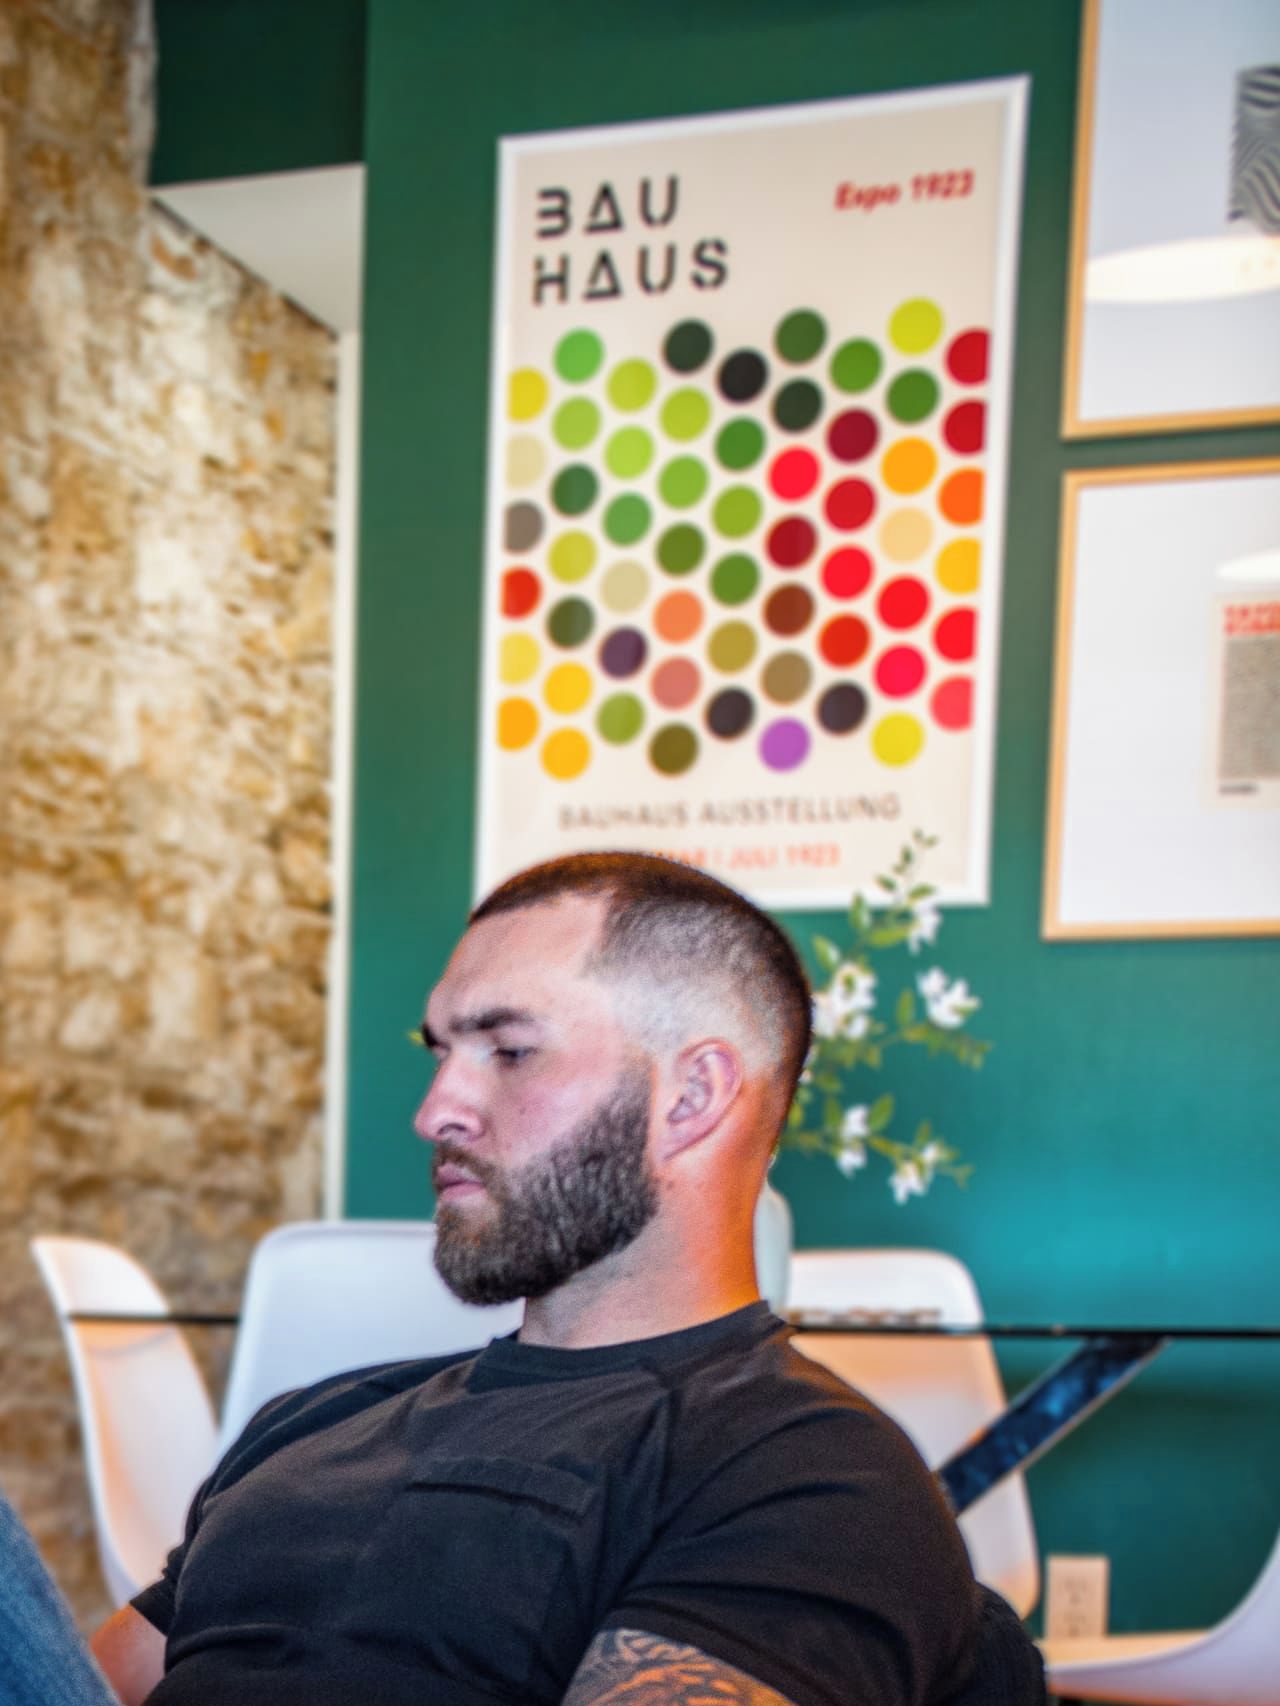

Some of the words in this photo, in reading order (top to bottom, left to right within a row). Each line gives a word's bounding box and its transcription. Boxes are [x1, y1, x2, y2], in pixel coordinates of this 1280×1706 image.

[536, 174, 678, 239] BAU
[834, 181, 901, 213] Expo
[911, 167, 974, 200] 1923
[532, 238, 728, 306] HAUS
[558, 801, 689, 831] BAUHAUS
[701, 792, 902, 826] AUSSTELLUNG
